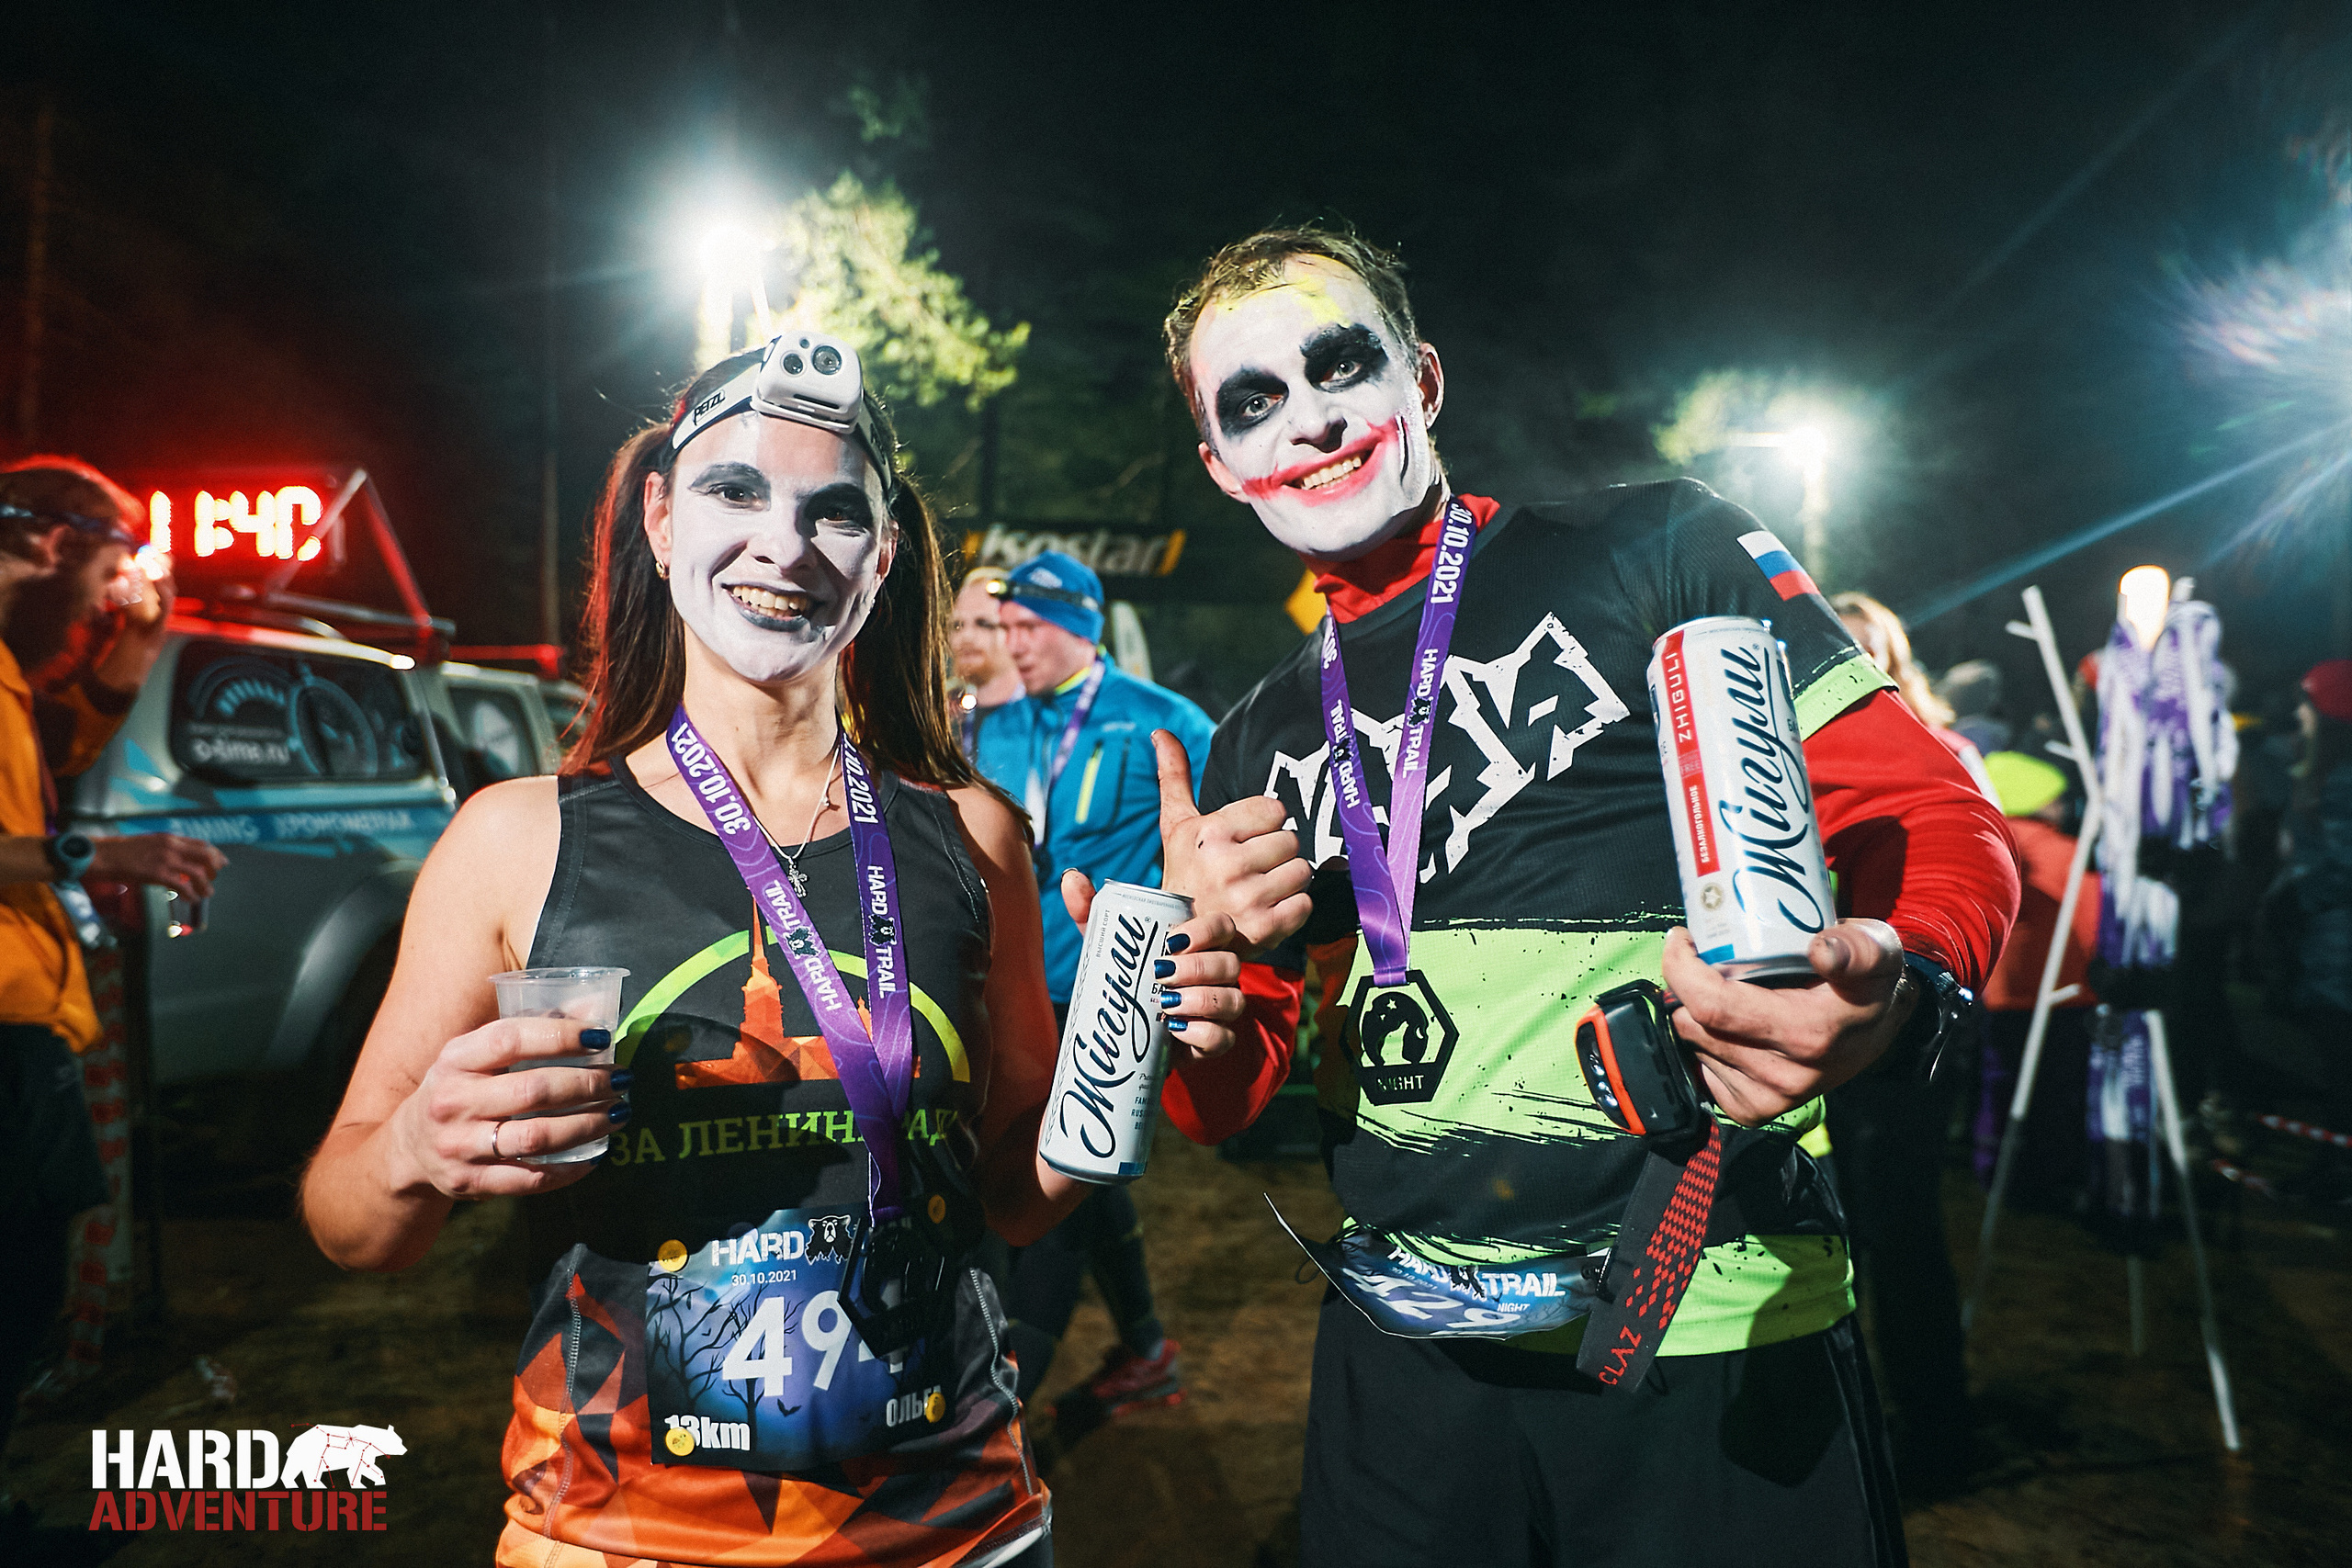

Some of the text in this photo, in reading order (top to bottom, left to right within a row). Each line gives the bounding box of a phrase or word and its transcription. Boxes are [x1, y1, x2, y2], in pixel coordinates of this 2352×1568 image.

[693, 391, 726, 426] PETZL
[1430, 502, 1472, 604] 30.10.2021
[1401, 649, 1439, 779] HARD TRAIL
[1665, 651, 1692, 744] ZHIGULI
[672, 723, 752, 835] 30.10.2021
[842, 732, 879, 824] .10.2021
[1330, 698, 1361, 809] HARD TRAIL
[1718, 646, 1826, 934] Жигули
[1689, 784, 1710, 863] БЕЗАЛКОГОЛЬНОЕ
[764, 879, 842, 1011] HARD TRAIL
[868, 865, 898, 999] HARD TRAIL
[1096, 926, 1107, 959] ВЫСШИЙ
[1059, 913, 1159, 1159] Жигули
[609, 1108, 957, 1167] ЗА ЛЕНИНАД
[711, 1230, 806, 1267] HARD
[730, 1269, 797, 1287] 30.10.2021
[1386, 1246, 1566, 1297] HARD TRAIL
[1341, 1267, 1522, 1328] 429
[1496, 1302, 1532, 1313] NIGHT
[886, 1384, 942, 1427] ОЛЬГ
